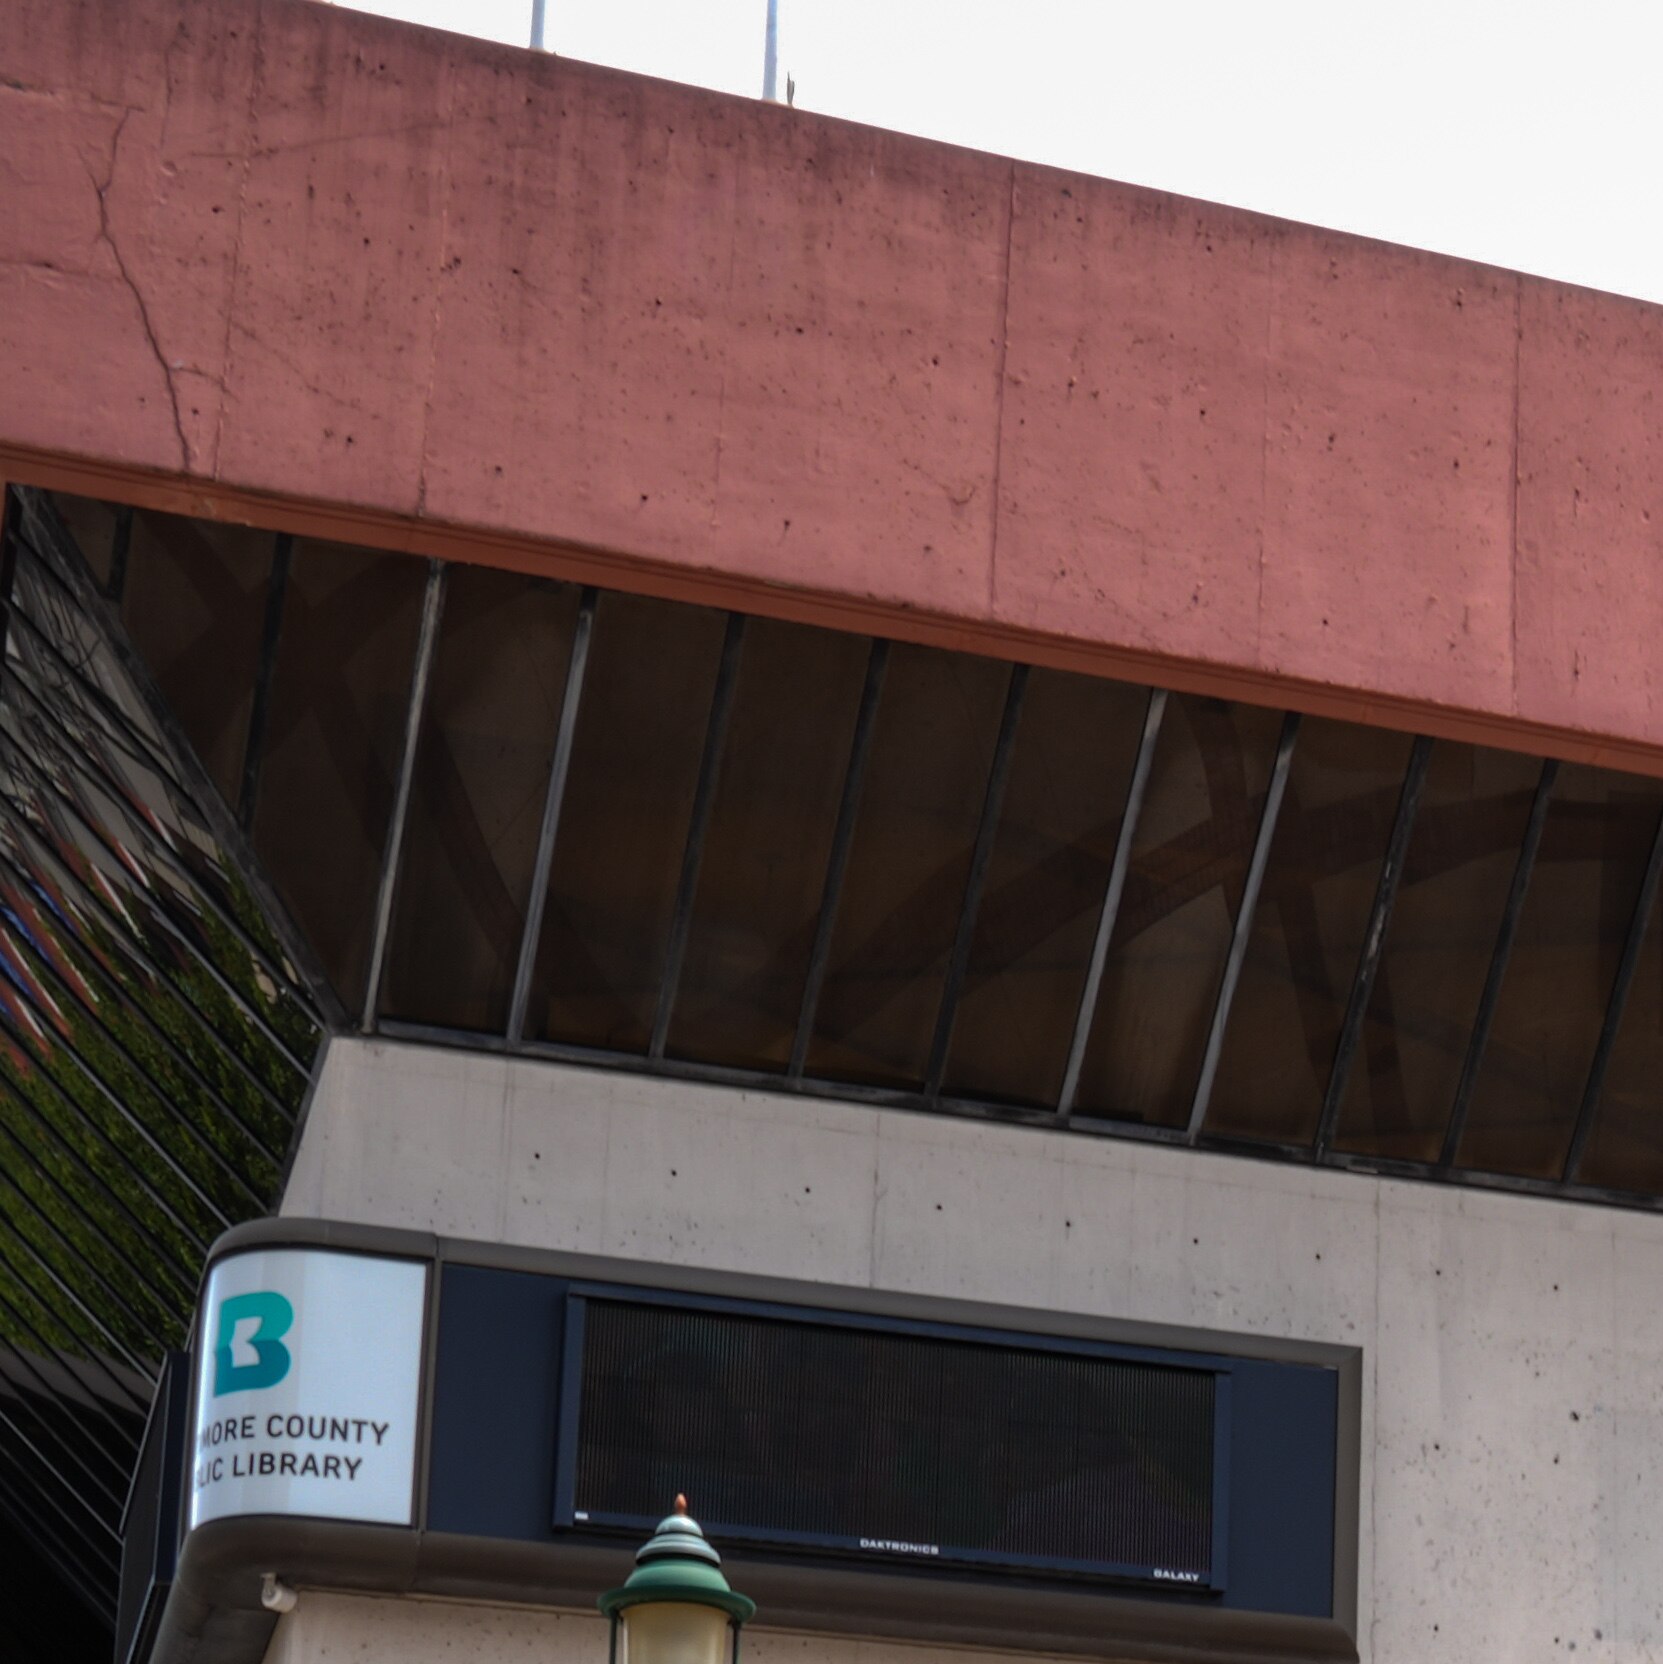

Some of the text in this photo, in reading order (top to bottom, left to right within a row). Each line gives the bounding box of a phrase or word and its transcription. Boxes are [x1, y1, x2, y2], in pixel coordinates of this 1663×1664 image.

[266, 1414, 390, 1447] COUNTY
[232, 1453, 363, 1481] LIBRARY
[860, 1538, 939, 1555] DAKTRONICS
[1153, 1567, 1199, 1582] GALAXY
